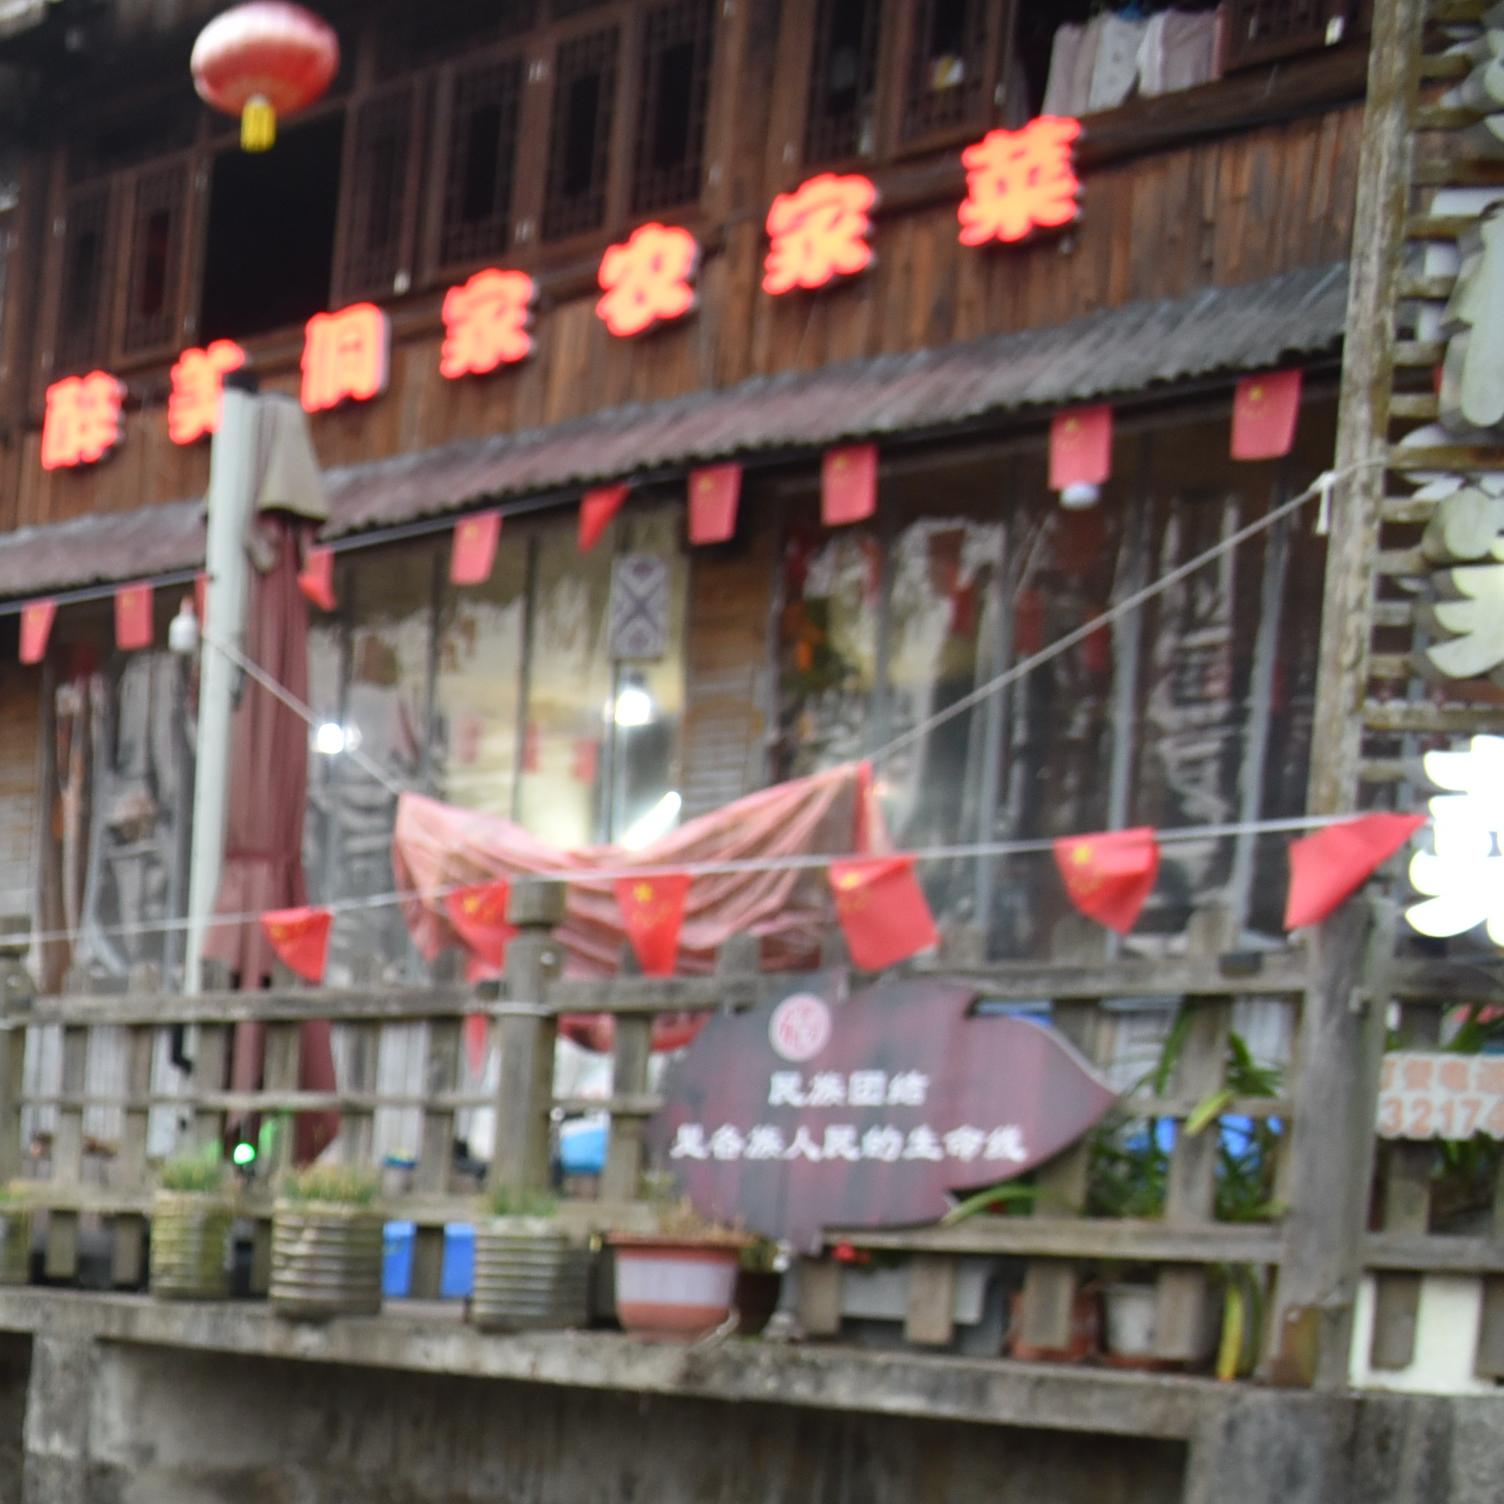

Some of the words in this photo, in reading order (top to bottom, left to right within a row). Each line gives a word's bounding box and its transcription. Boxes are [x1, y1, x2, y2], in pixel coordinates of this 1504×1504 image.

[768, 1069, 930, 1107] 民族团结
[670, 1122, 1027, 1162] 是各族人民的生命线
